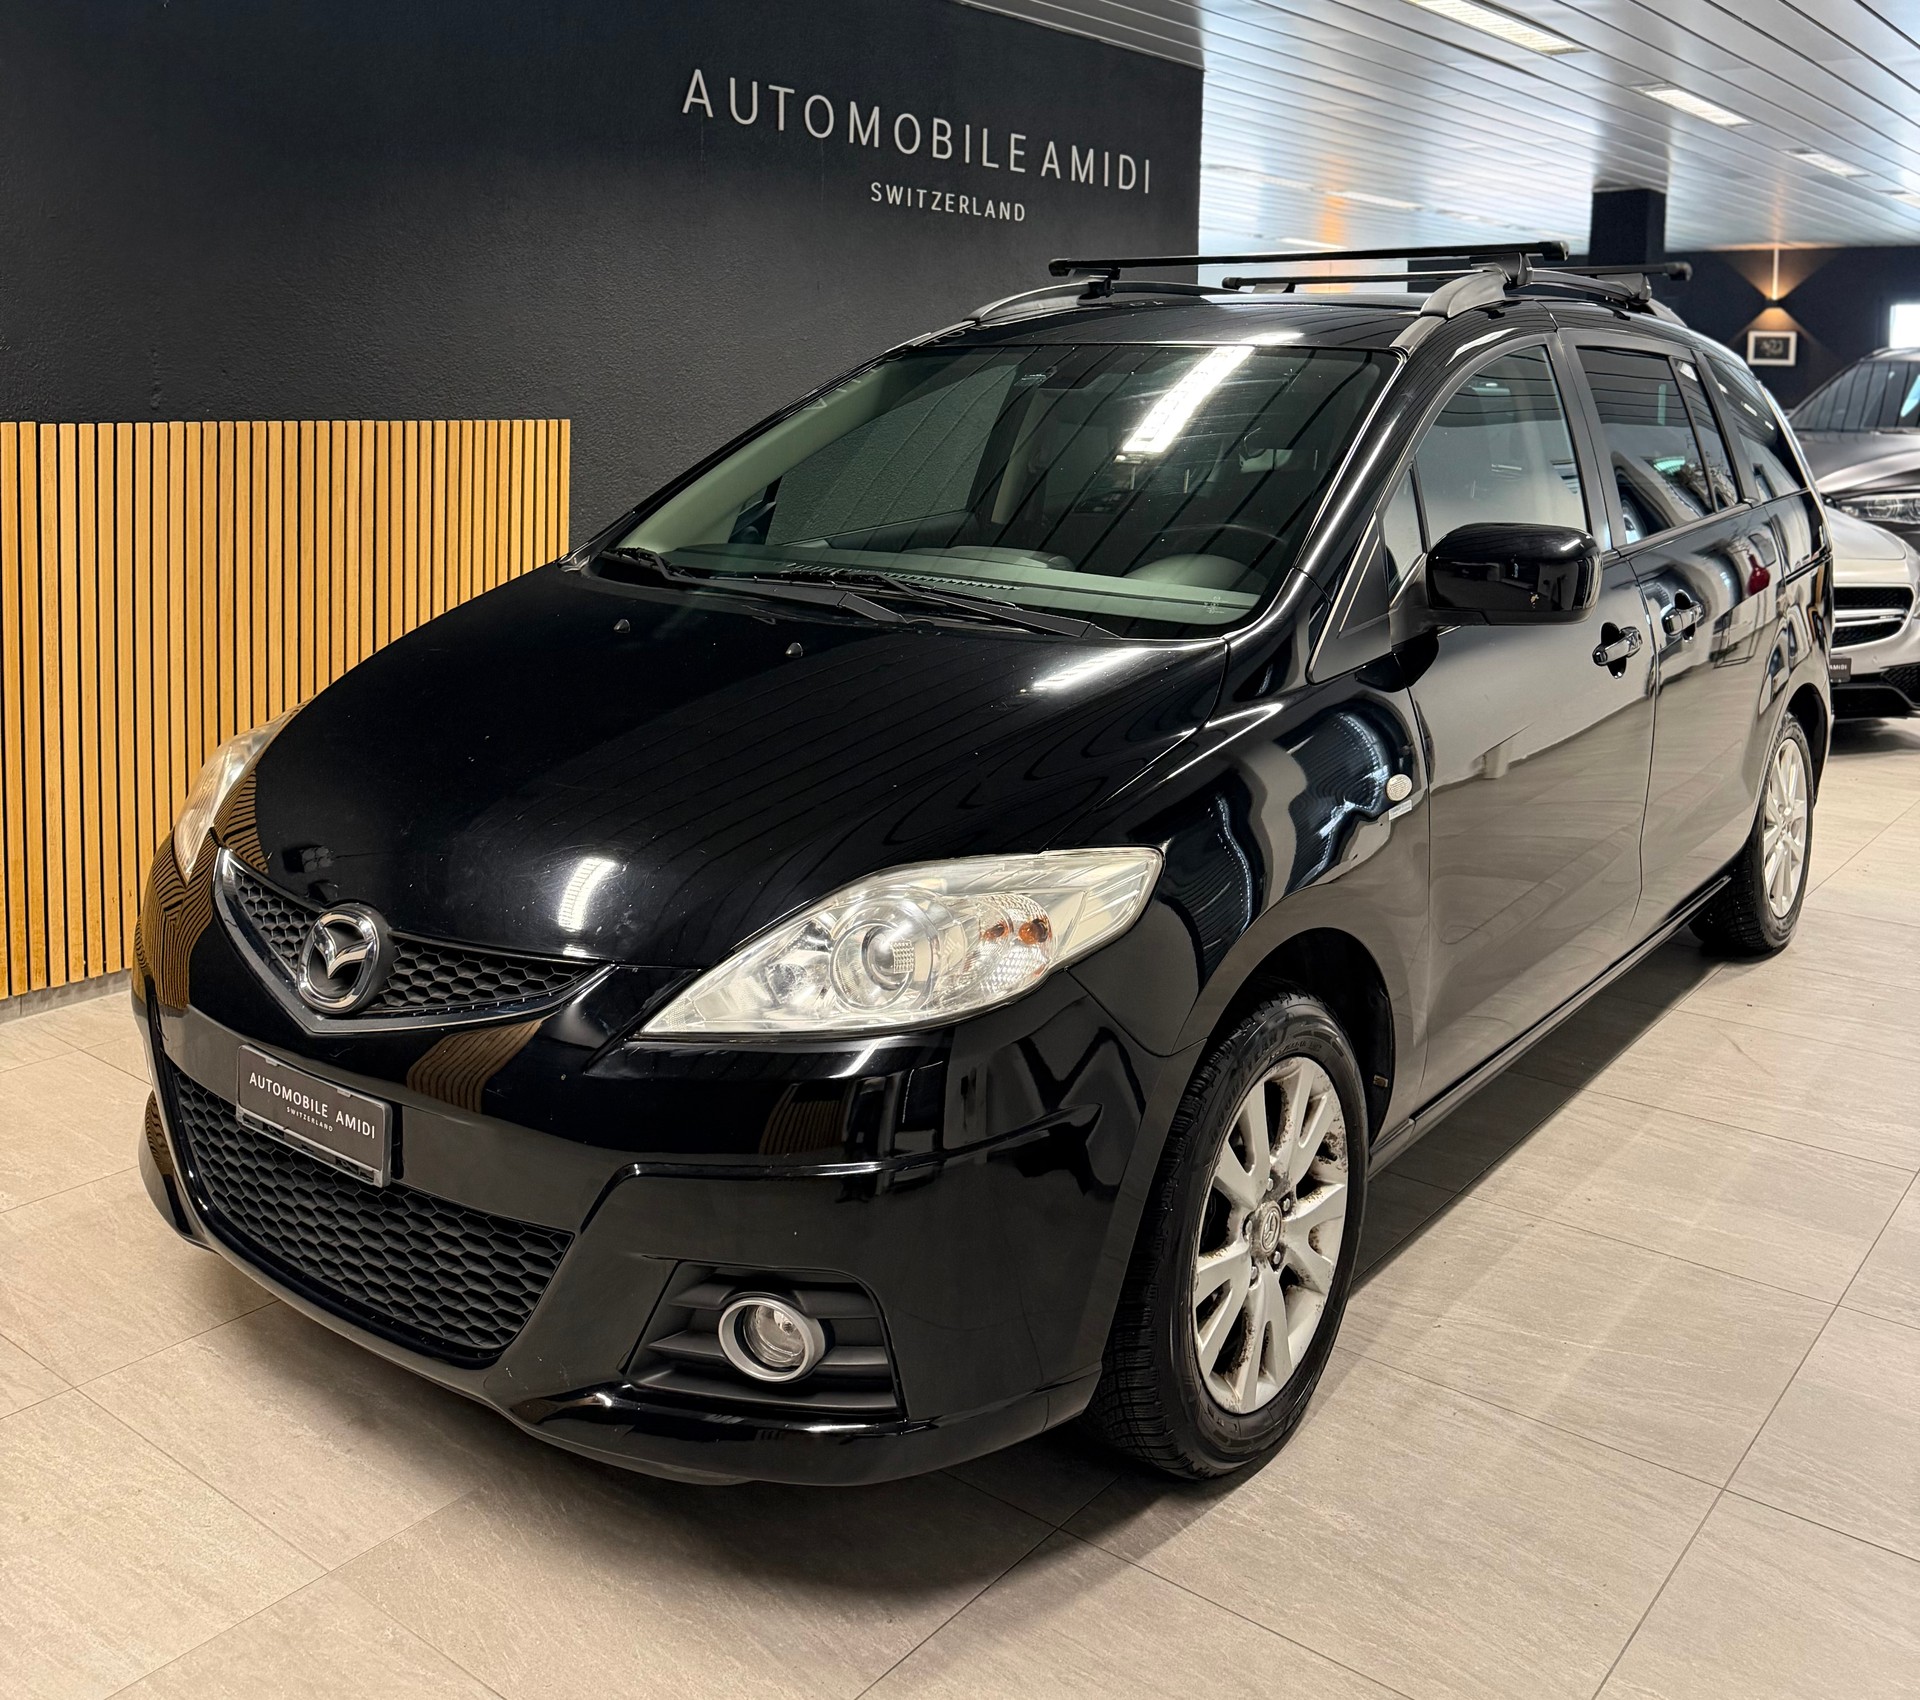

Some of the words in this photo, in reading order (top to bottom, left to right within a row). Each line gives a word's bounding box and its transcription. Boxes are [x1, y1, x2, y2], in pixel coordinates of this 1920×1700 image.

[682, 69, 1027, 173] AUTOMOBILE
[1040, 141, 1150, 194] AMIDI
[871, 181, 1025, 222] SWITZERLAND
[249, 1072, 328, 1118] AUTOMOBILE
[335, 1110, 375, 1139] AMIDI
[286, 1106, 333, 1132] SWITZERLAND
